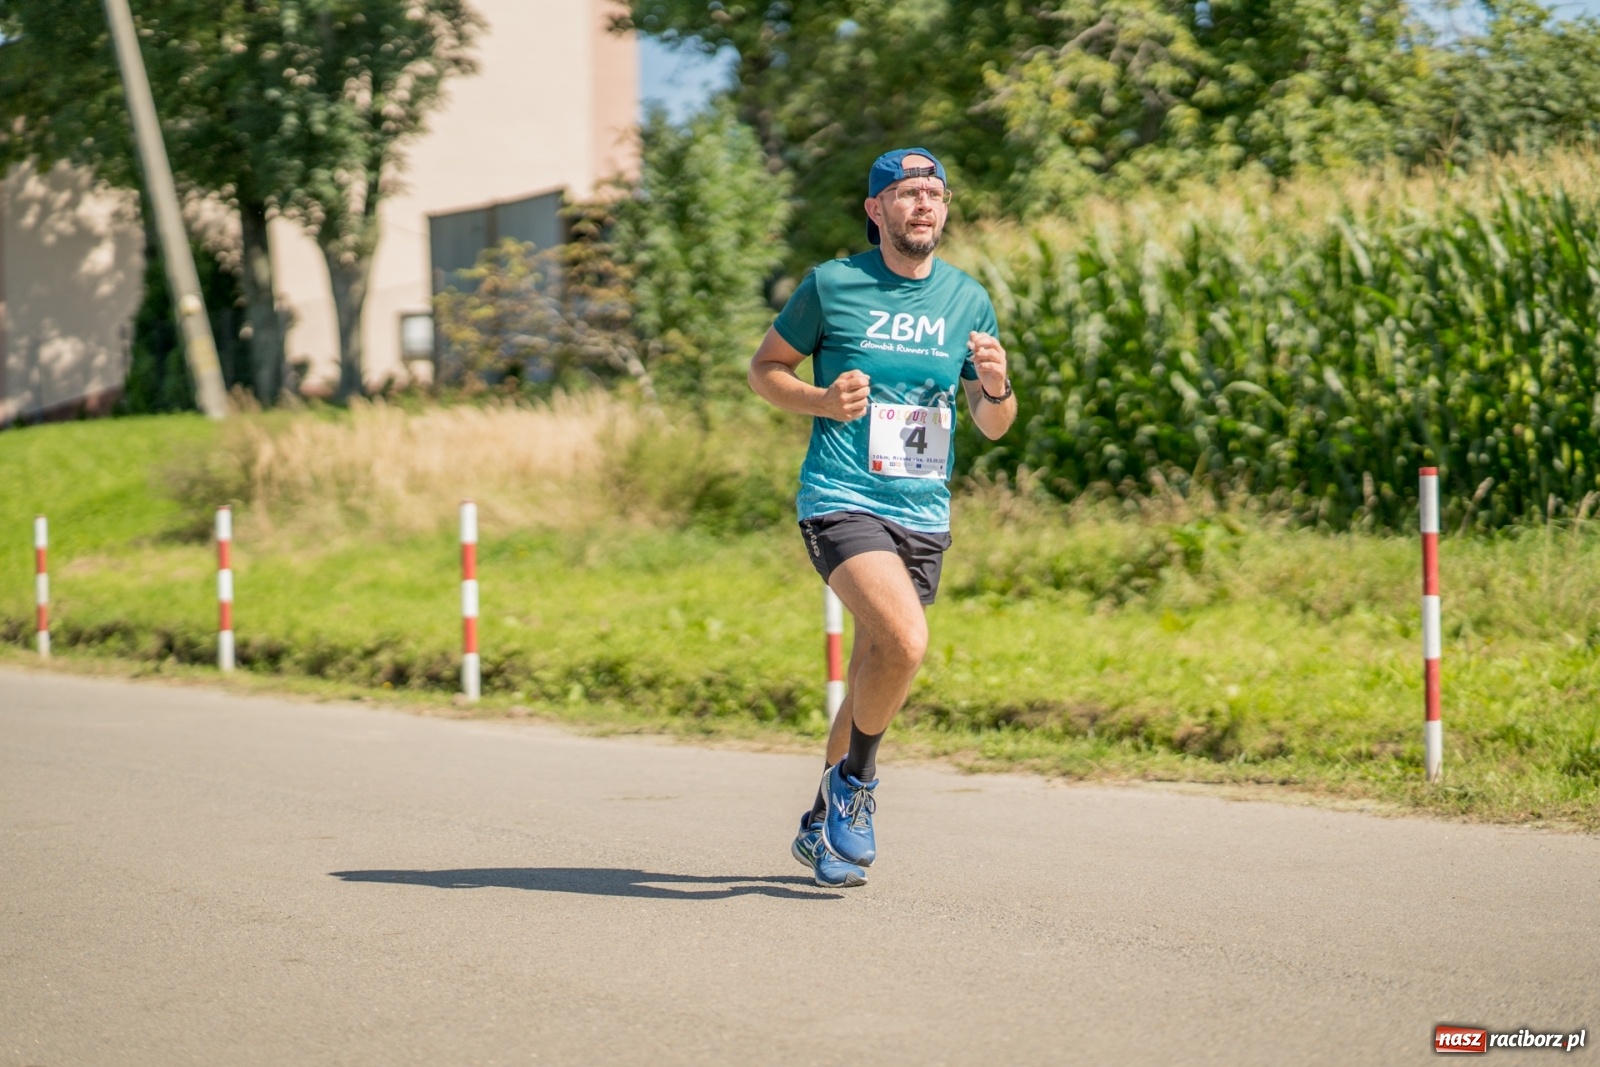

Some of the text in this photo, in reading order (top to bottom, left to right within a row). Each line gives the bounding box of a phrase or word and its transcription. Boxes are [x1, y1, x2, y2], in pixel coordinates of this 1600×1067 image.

[866, 310, 945, 345] ZBM
[896, 344, 929, 355] Runners
[931, 348, 949, 358] Team
[879, 408, 948, 425] COLOUR RUN
[905, 427, 928, 454] 4
